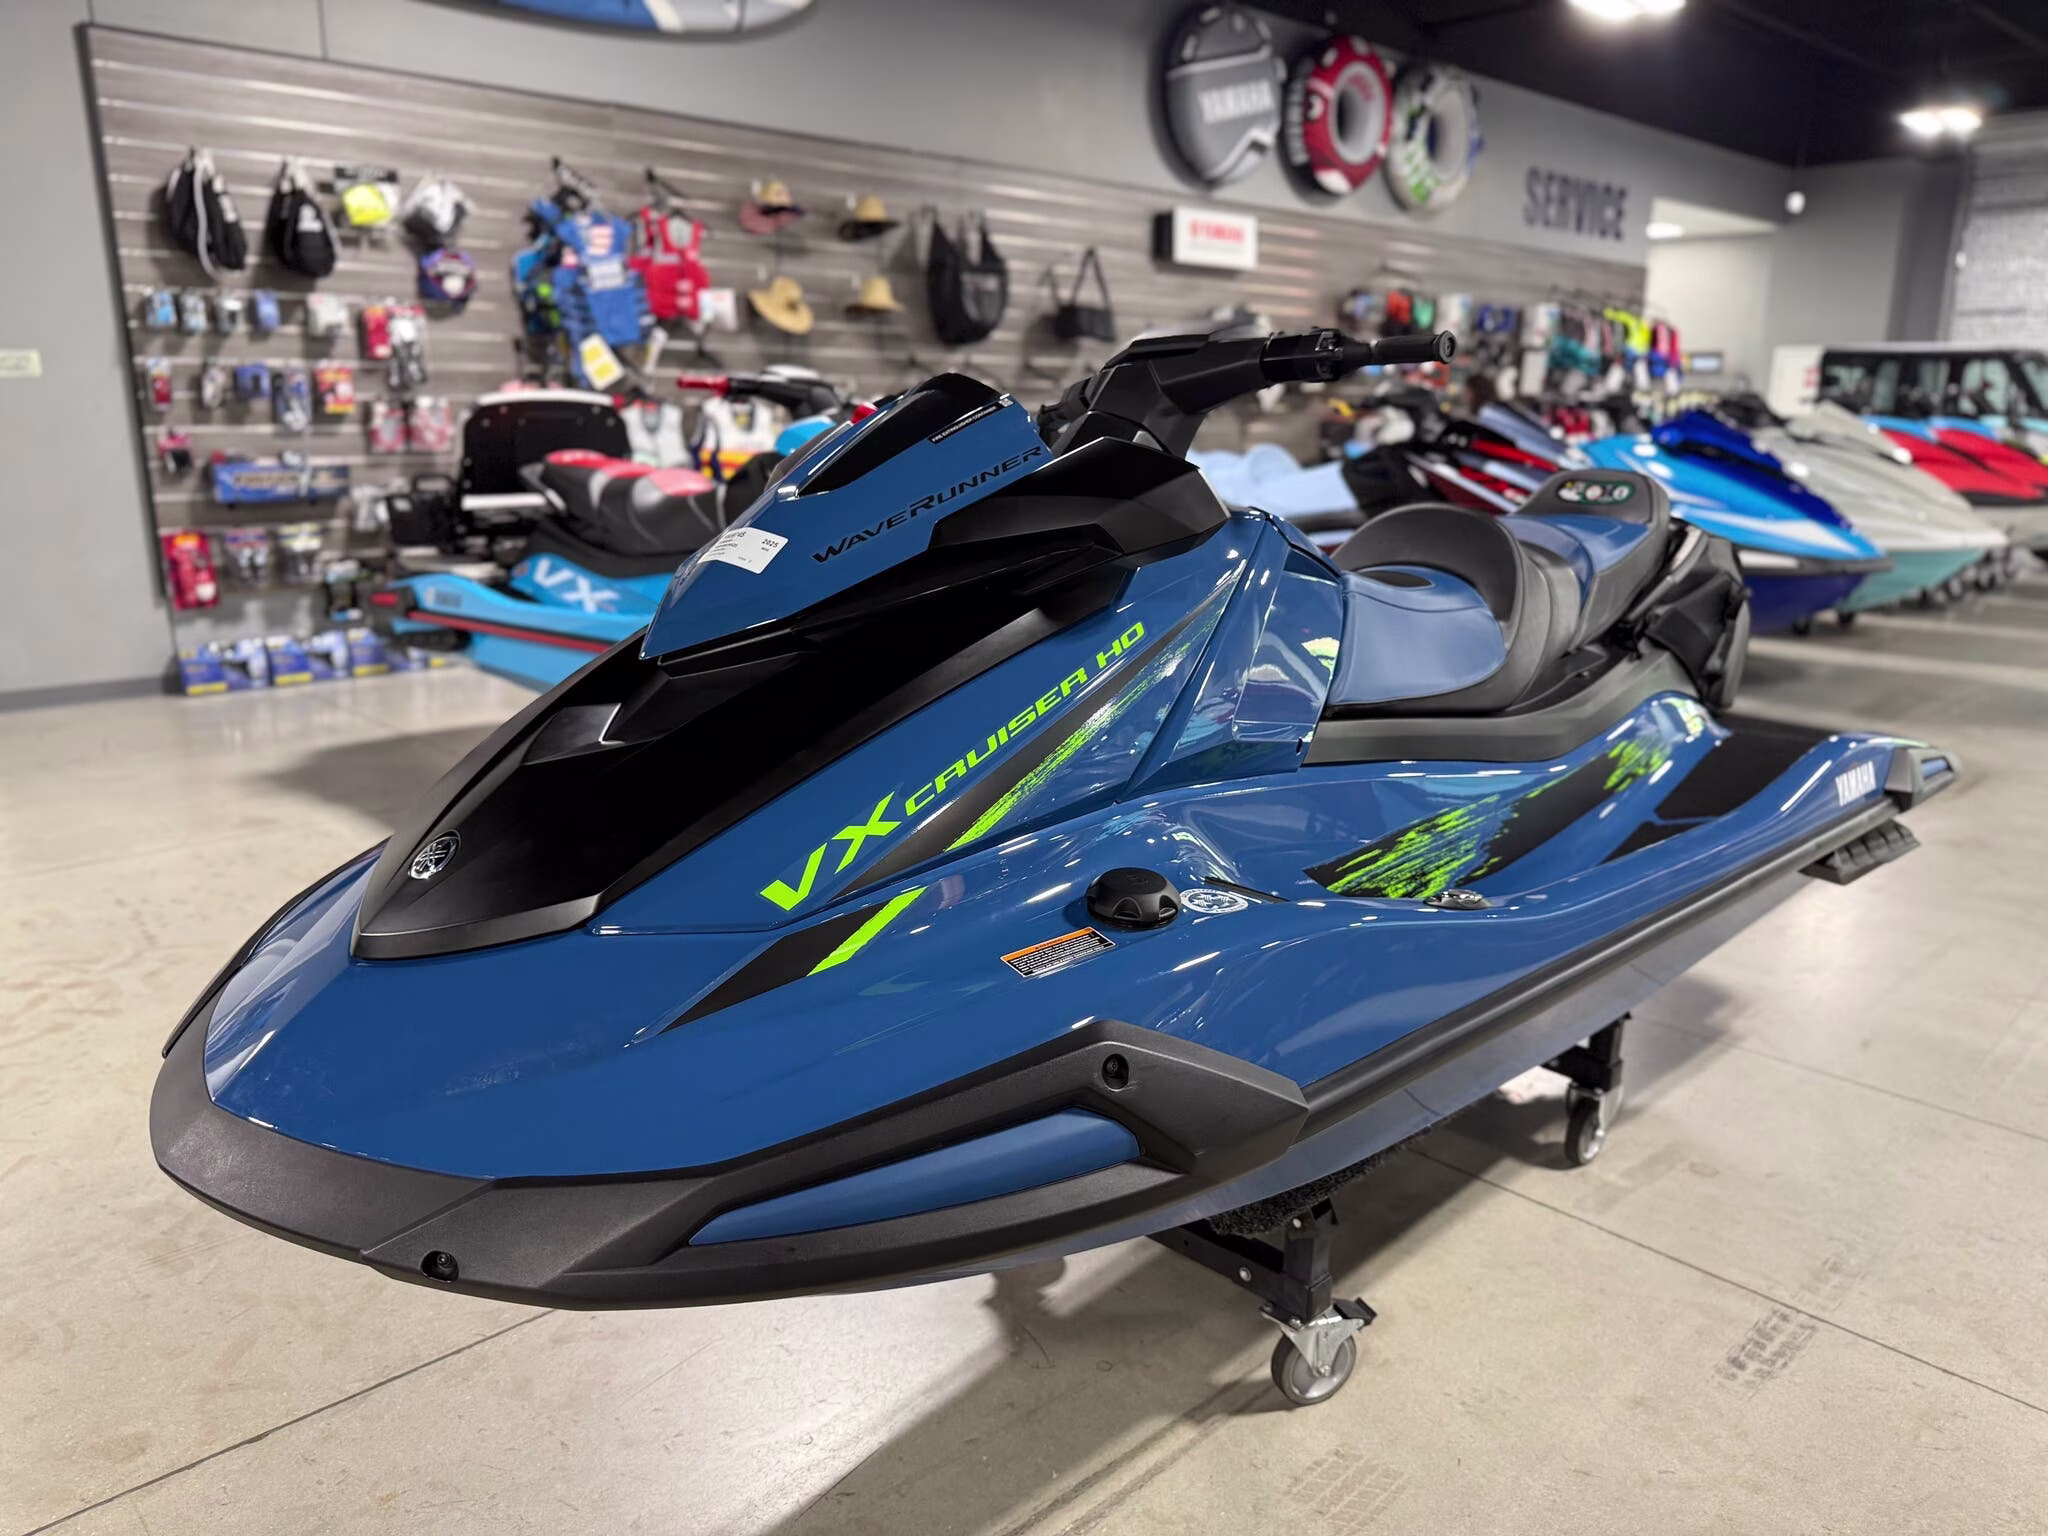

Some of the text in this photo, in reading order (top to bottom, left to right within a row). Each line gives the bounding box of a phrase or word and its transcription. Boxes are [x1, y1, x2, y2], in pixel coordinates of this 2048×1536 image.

[1524, 166, 1627, 240] SERVICE
[761, 538, 779, 548] 2025
[533, 558, 621, 613] VX
[760, 622, 1146, 911] VX CRUISER HO
